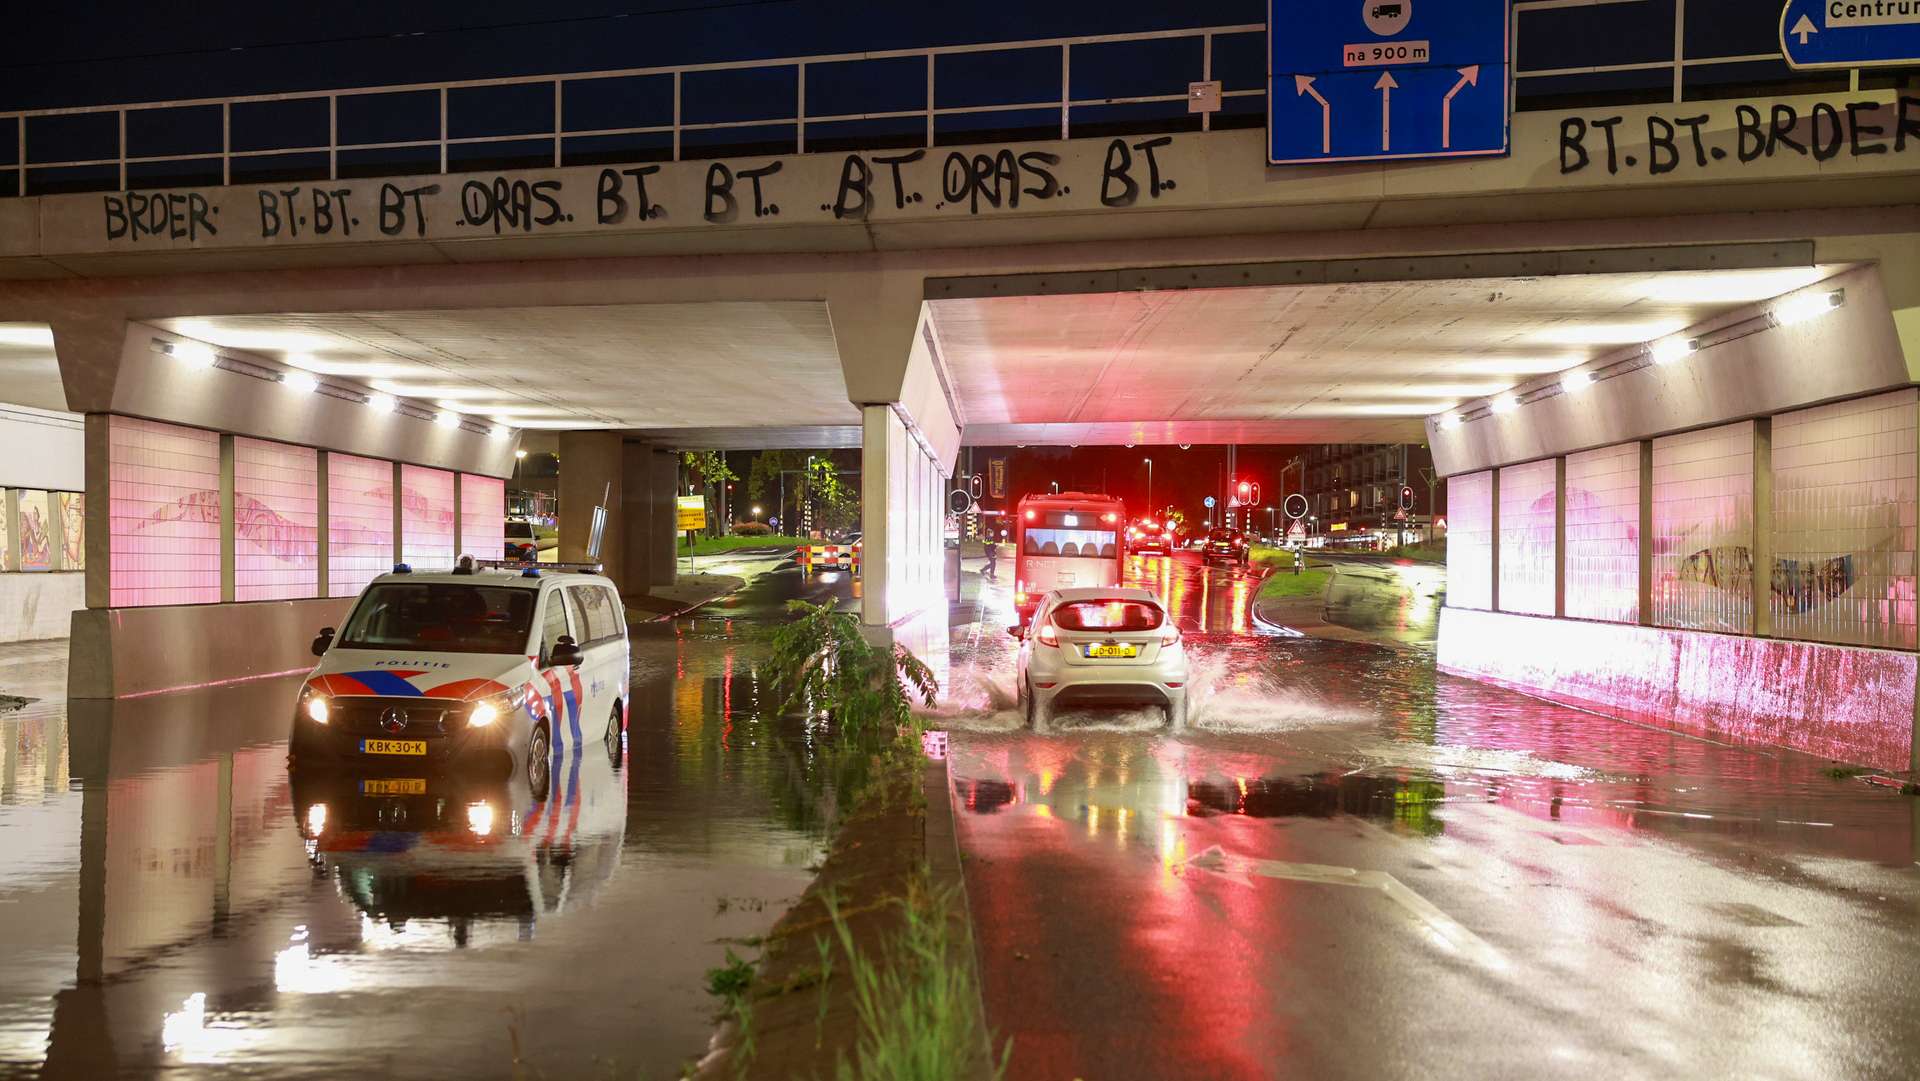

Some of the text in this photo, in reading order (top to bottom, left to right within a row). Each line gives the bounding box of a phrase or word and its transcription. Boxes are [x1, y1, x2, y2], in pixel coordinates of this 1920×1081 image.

[1346, 46, 1427, 62] na 900 m
[375, 660, 451, 669] POLITIE
[368, 741, 422, 753] KBK-30-K
